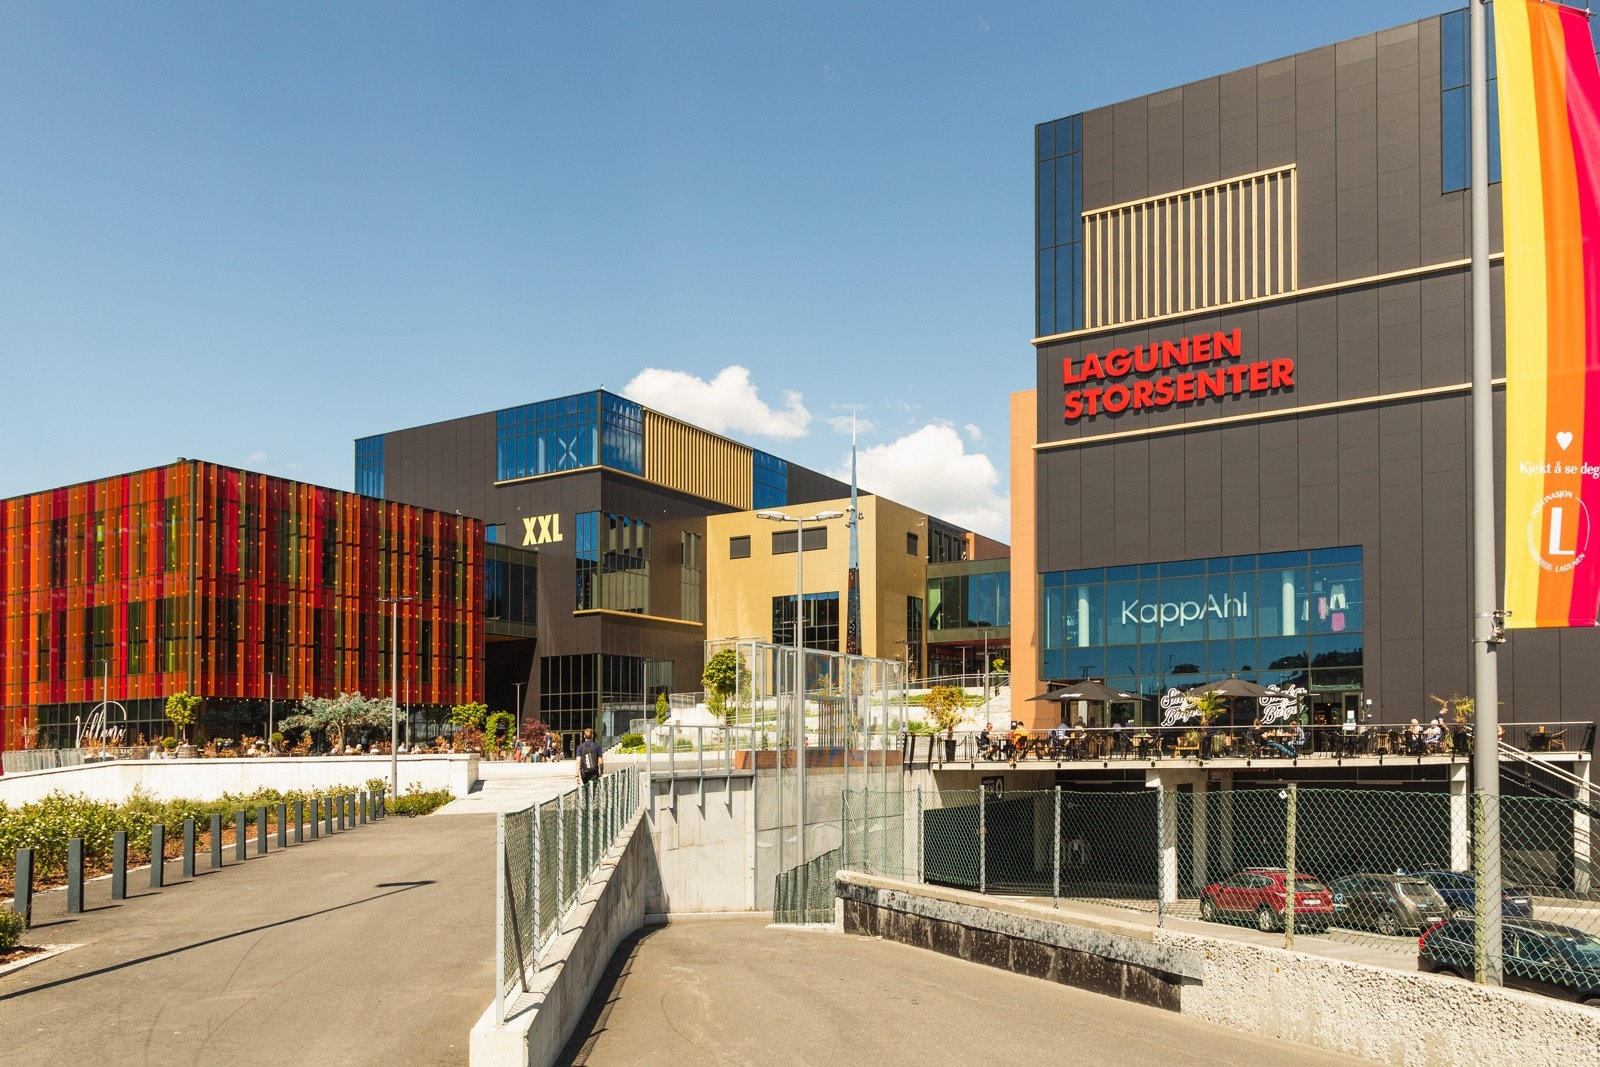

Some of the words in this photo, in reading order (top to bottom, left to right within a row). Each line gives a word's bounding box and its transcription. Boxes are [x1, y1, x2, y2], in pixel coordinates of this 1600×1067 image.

[1063, 327, 1242, 385] LAGUNEN
[1064, 357, 1295, 420] STORSENTER
[1519, 461, 1552, 477] Kjekt
[1554, 460, 1562, 475] å
[1564, 463, 1578, 475] se
[1580, 462, 1600, 480] deg
[1531, 490, 1573, 519] DESTINASJON
[522, 510, 563, 547] XXL
[1549, 507, 1575, 555] L
[1555, 552, 1586, 573] LAGUNEN
[1122, 591, 1247, 628] KappAhl
